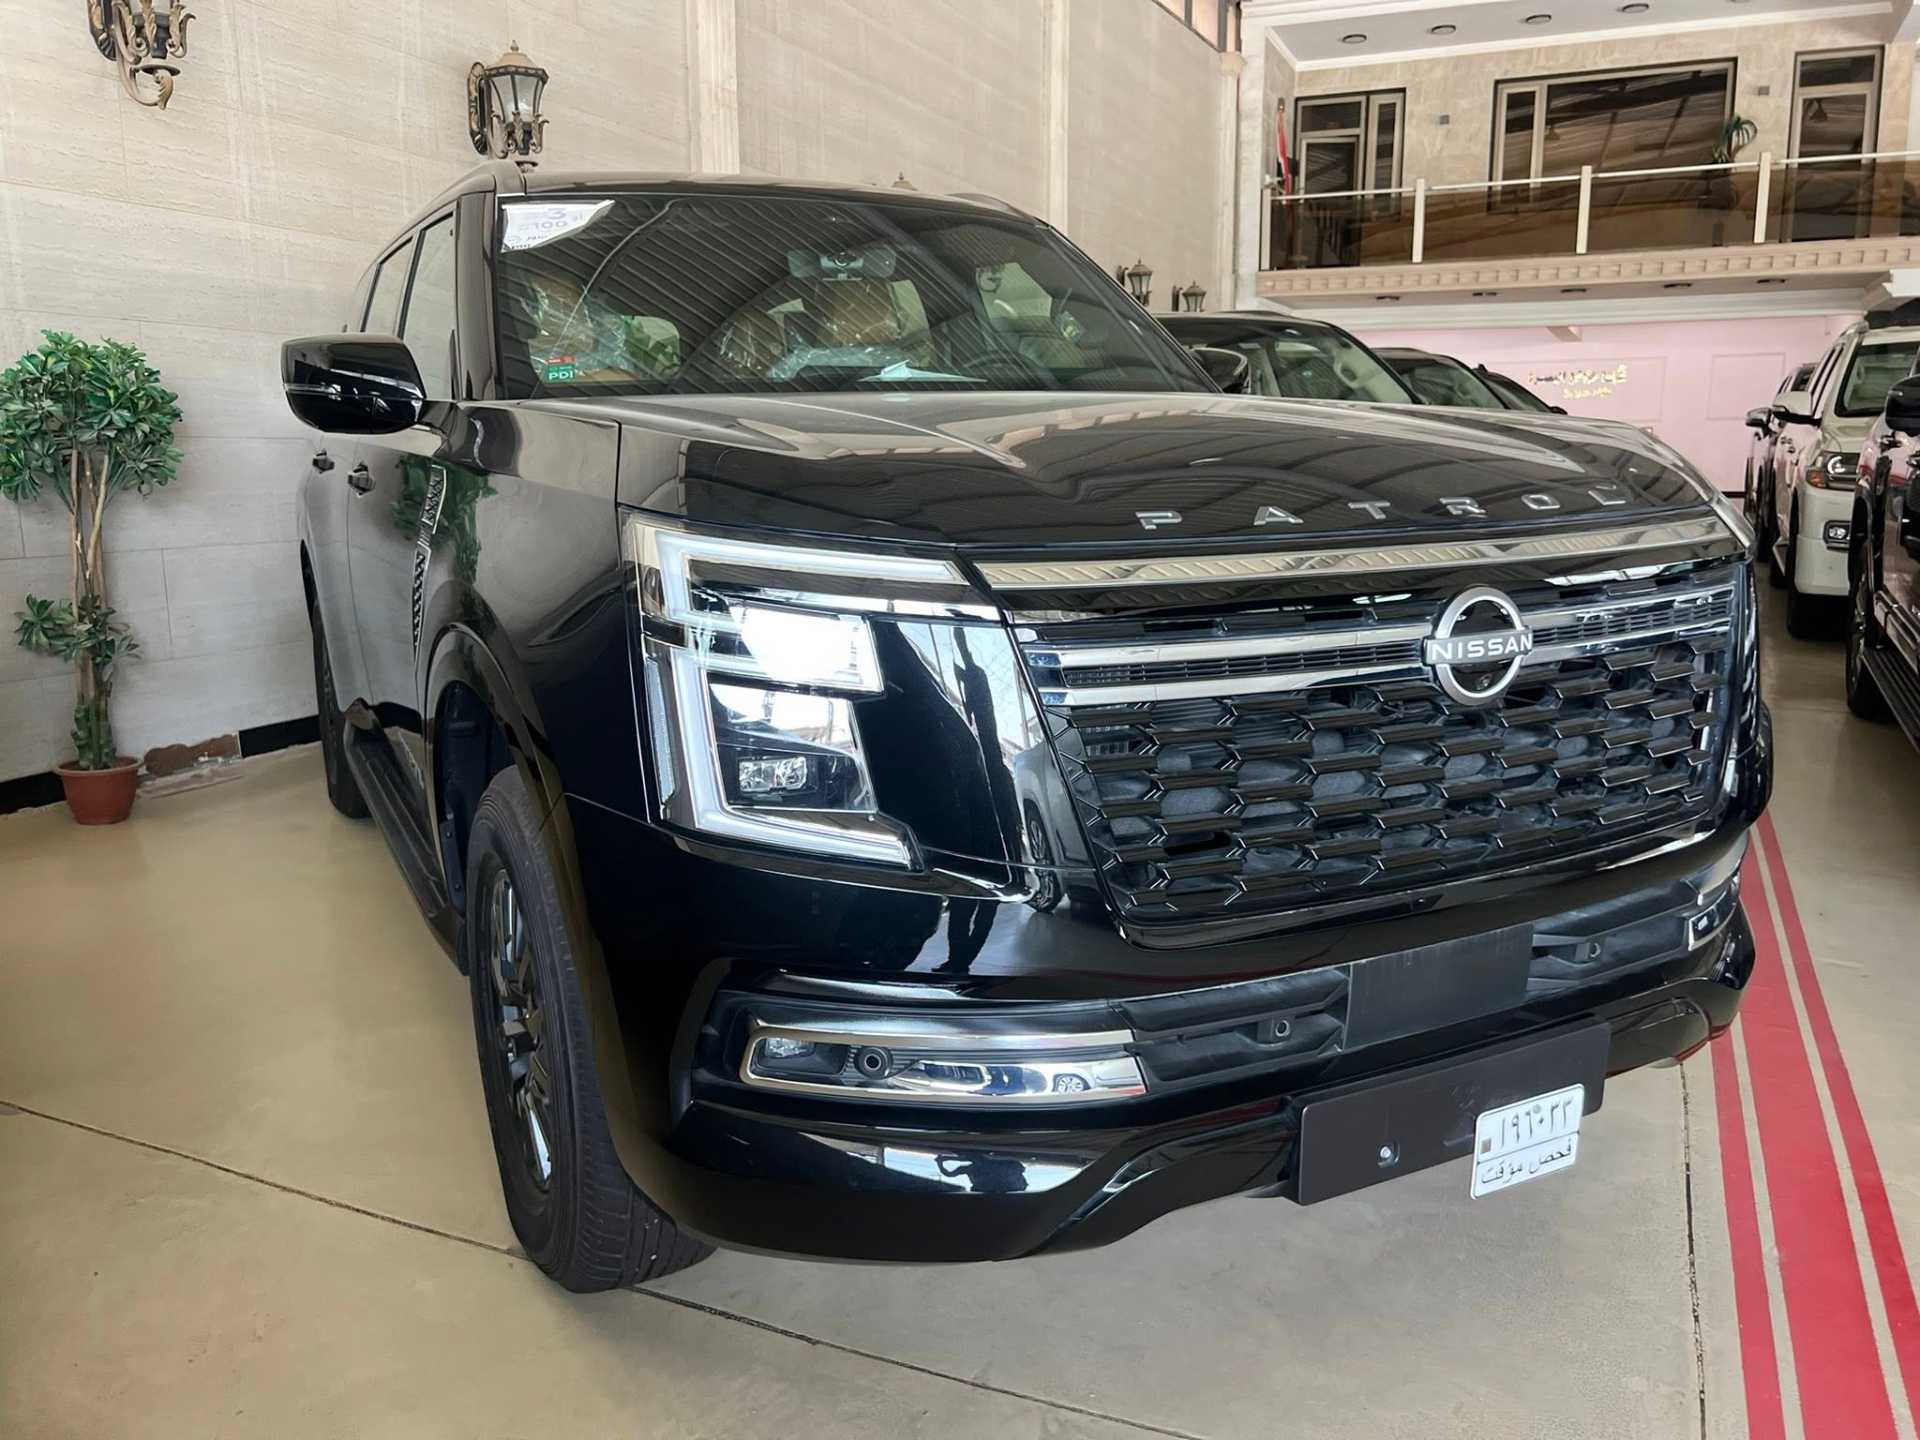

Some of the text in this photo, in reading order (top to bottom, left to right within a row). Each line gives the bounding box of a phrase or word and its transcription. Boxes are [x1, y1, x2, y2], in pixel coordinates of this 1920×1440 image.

[548, 370, 574, 381] PDI
[1135, 484, 1627, 530] PATROL
[1430, 627, 1533, 661] NISSAN
[1481, 1138, 1573, 1185] فحص مؤقت
